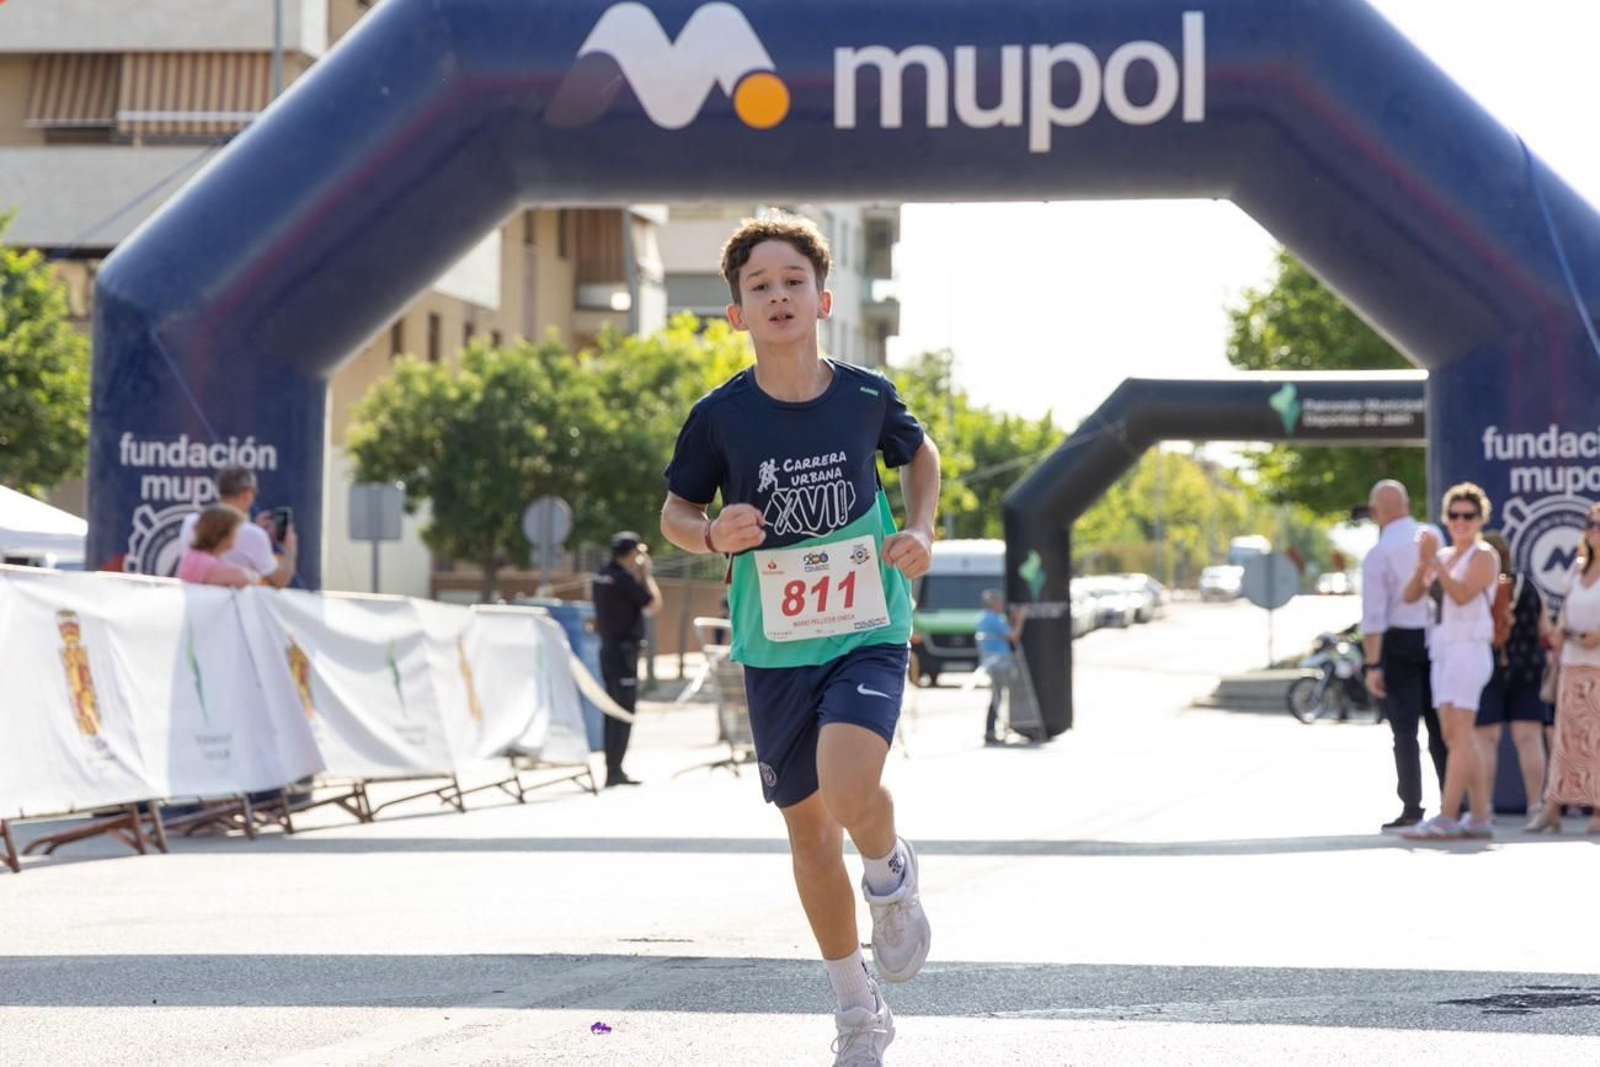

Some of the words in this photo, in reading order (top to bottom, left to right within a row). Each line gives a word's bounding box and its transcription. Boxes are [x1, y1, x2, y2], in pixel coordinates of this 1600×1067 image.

[834, 11, 1204, 152] mupol
[119, 432, 277, 470] fundación
[1482, 423, 1600, 460] fundac
[783, 451, 847, 472] CARRERA
[791, 467, 842, 486] URBANA
[141, 474, 219, 509] mup
[781, 570, 856, 617] 811
